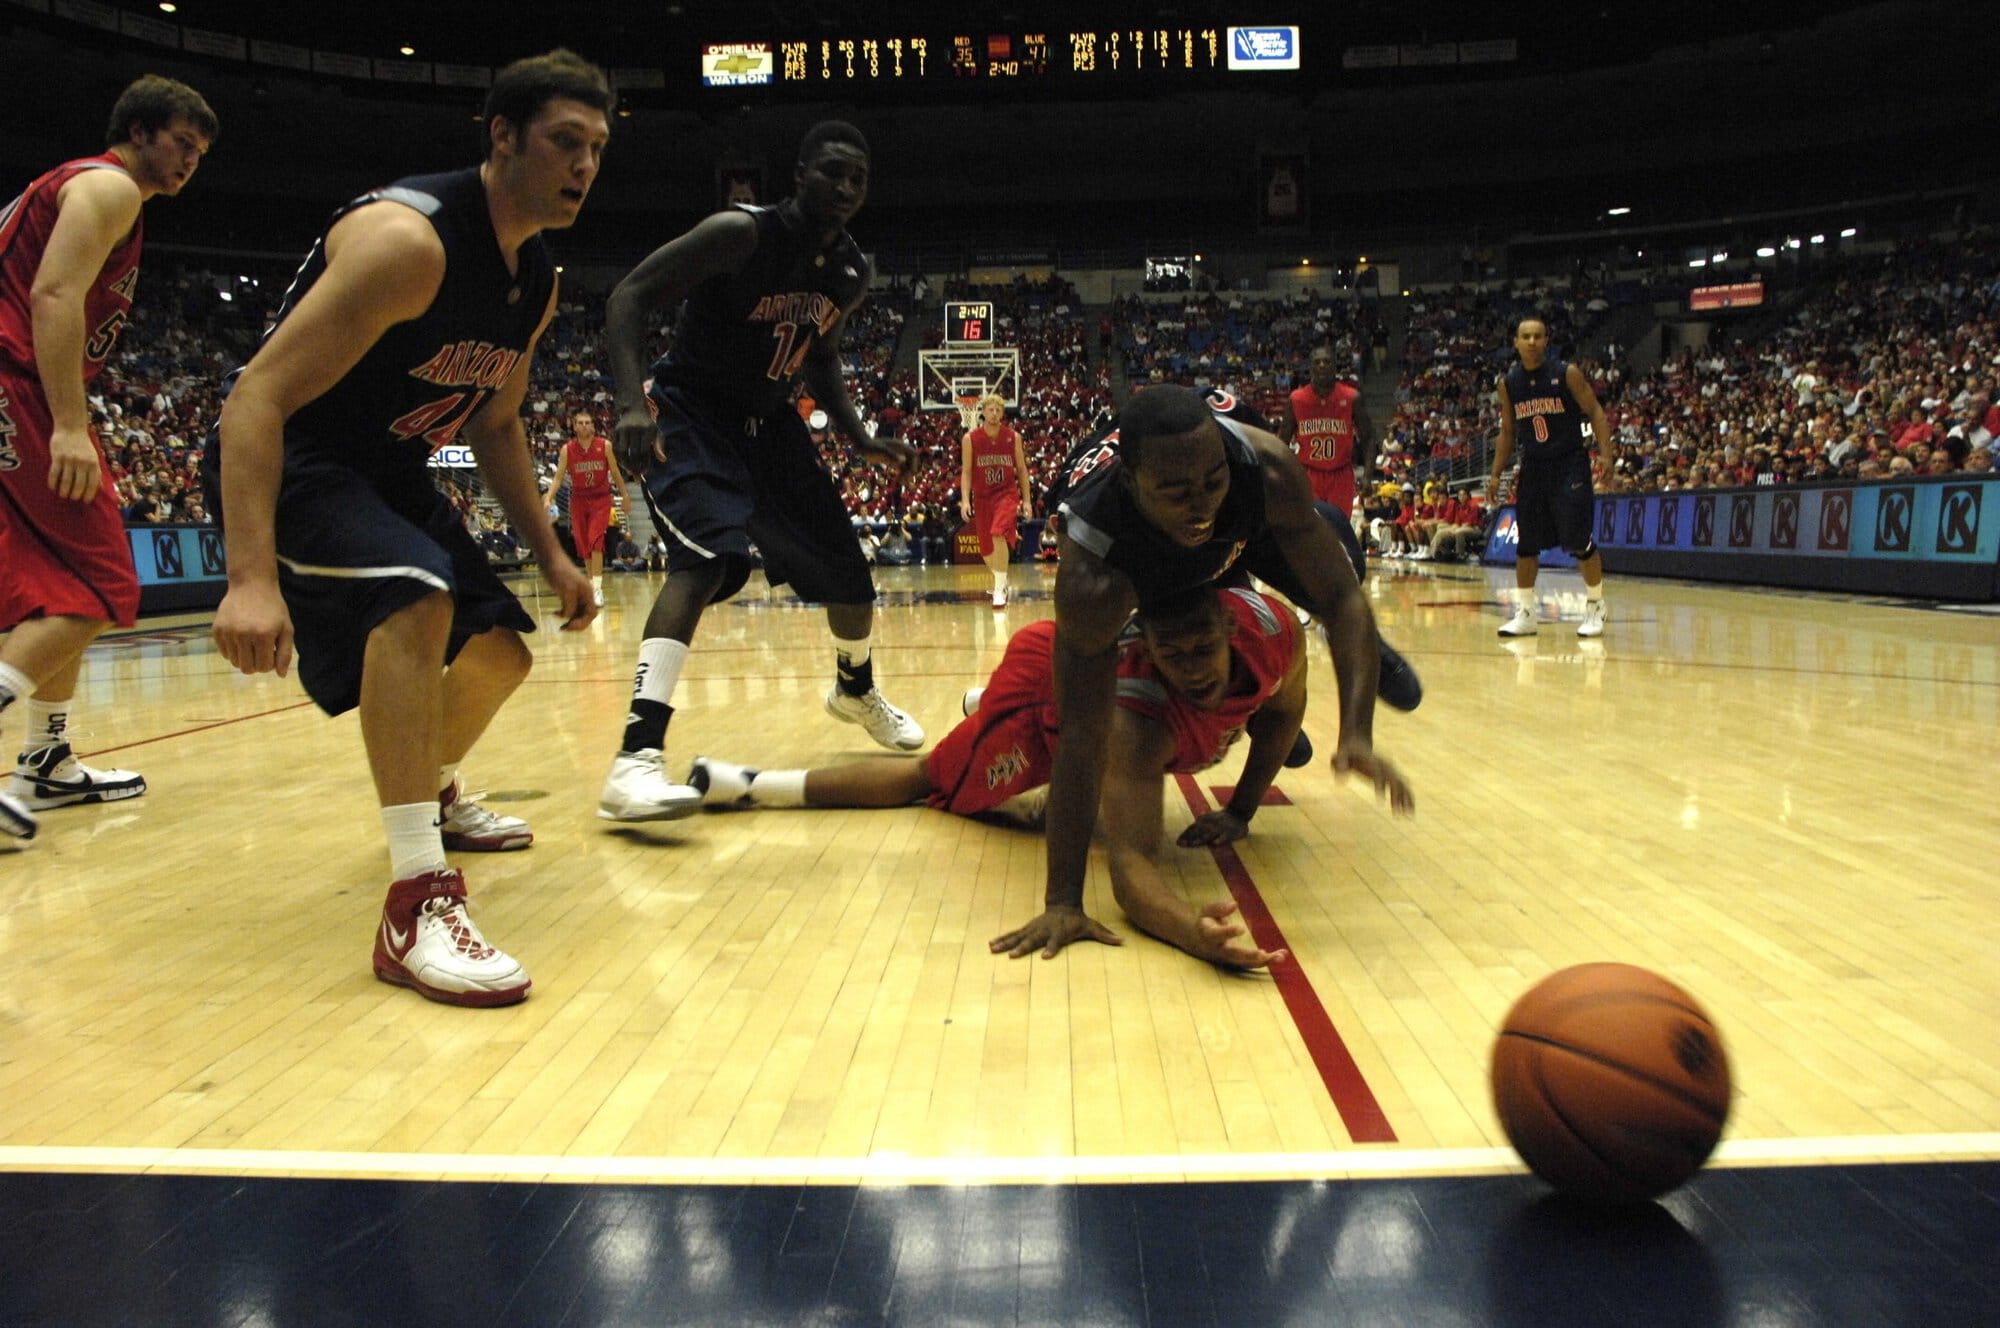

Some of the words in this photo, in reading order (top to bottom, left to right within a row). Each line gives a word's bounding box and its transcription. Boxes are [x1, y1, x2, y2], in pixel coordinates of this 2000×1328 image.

[954, 36, 970, 46] RED
[1024, 34, 1045, 45] BLUE
[708, 44, 766, 55] O'RIELLY
[1029, 46, 1046, 60] 41
[989, 61, 1018, 77] 2:40
[709, 75, 767, 86] WATSON
[959, 305, 987, 319] 2:40
[963, 320, 982, 340] 16
[1514, 396, 1565, 420] ARIZONA
[1298, 418, 1347, 436] ARIZONA
[1532, 415, 1549, 443] 0
[1309, 437, 1336, 461] 20
[976, 454, 1014, 467] ARIZONA
[584, 472, 594, 488] 2
[985, 467, 1005, 485] 34
